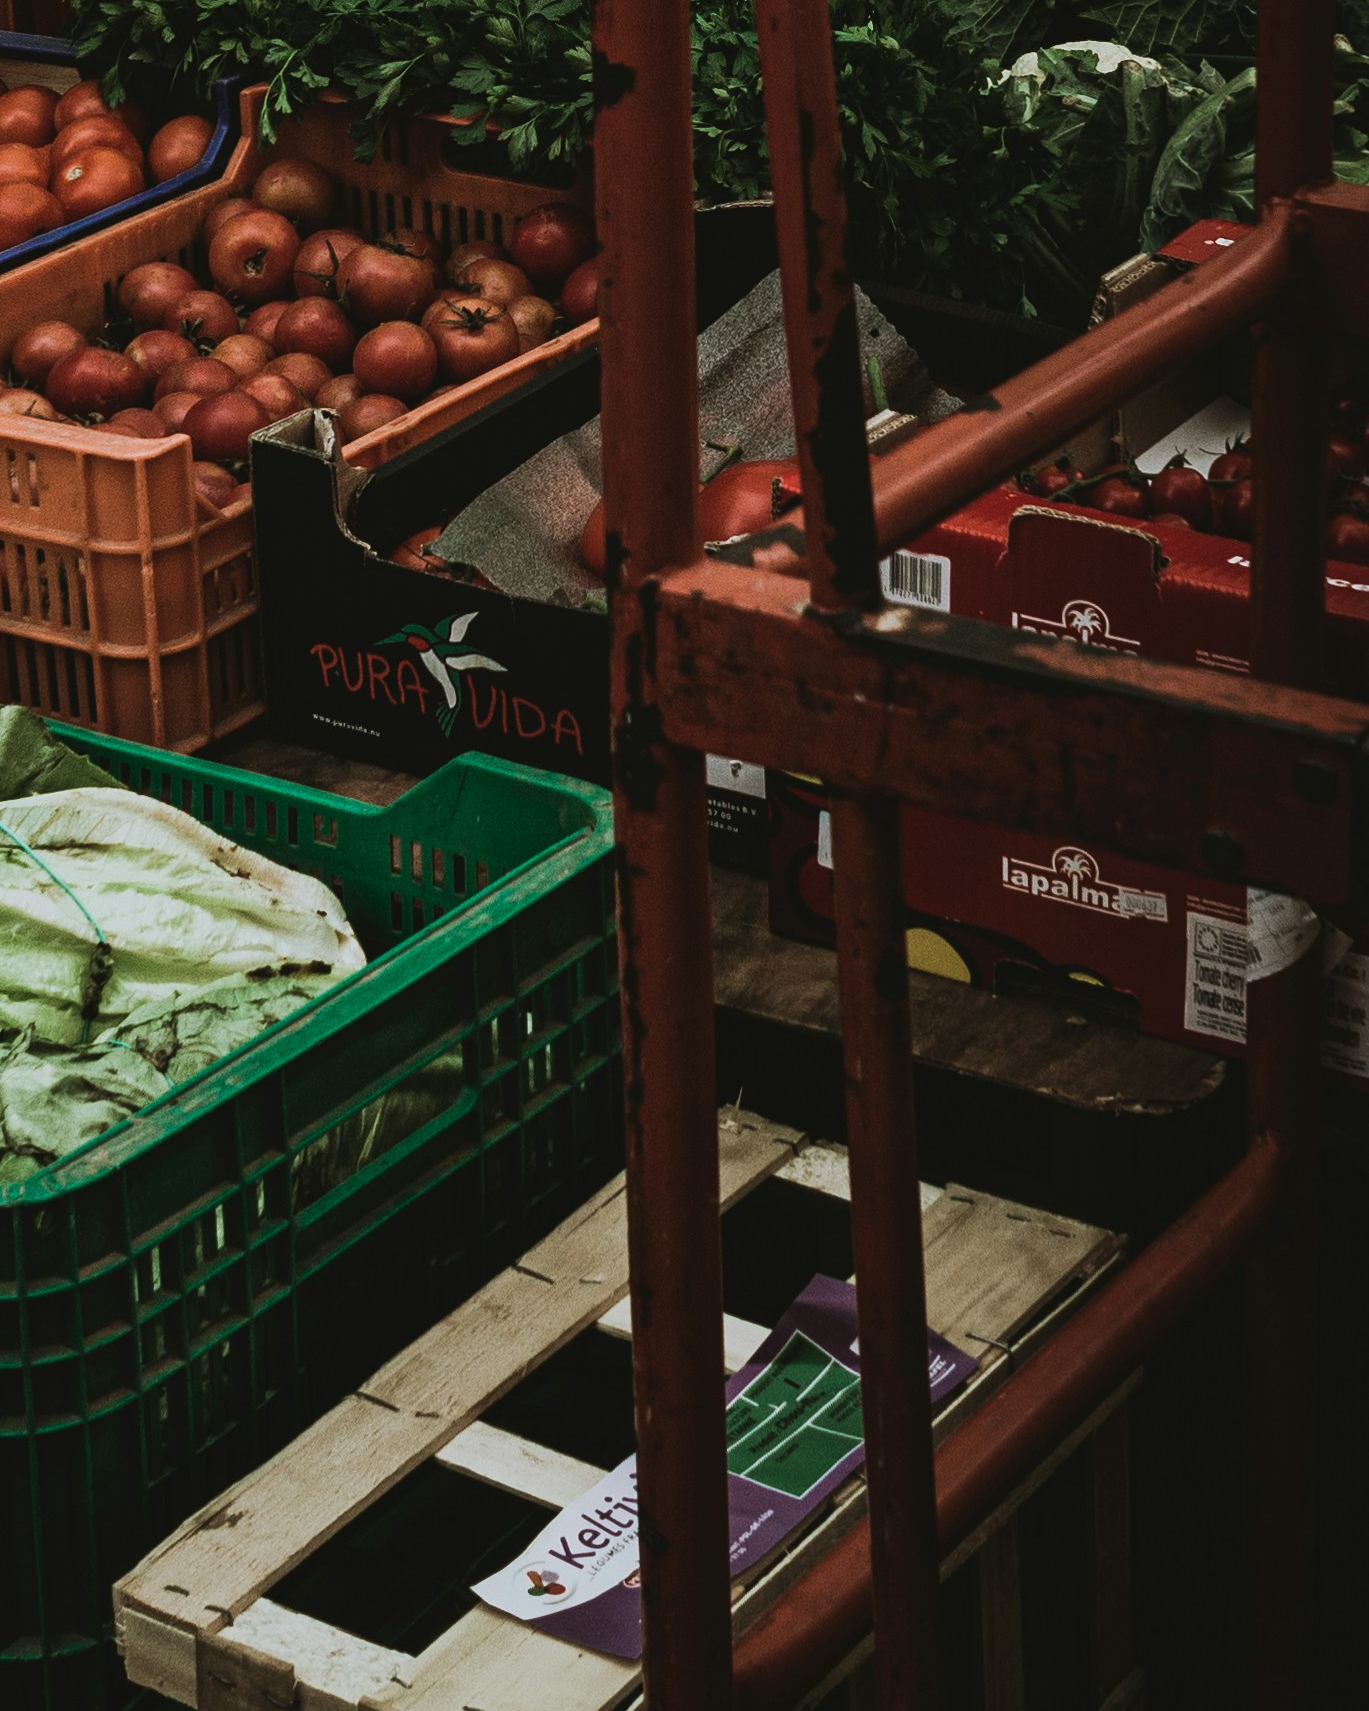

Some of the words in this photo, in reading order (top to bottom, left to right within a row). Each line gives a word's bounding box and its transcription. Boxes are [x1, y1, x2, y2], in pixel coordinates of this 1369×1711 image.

[310, 643, 429, 716] PURA
[466, 673, 583, 755] VIDA
[1002, 856, 1121, 913] lapalma
